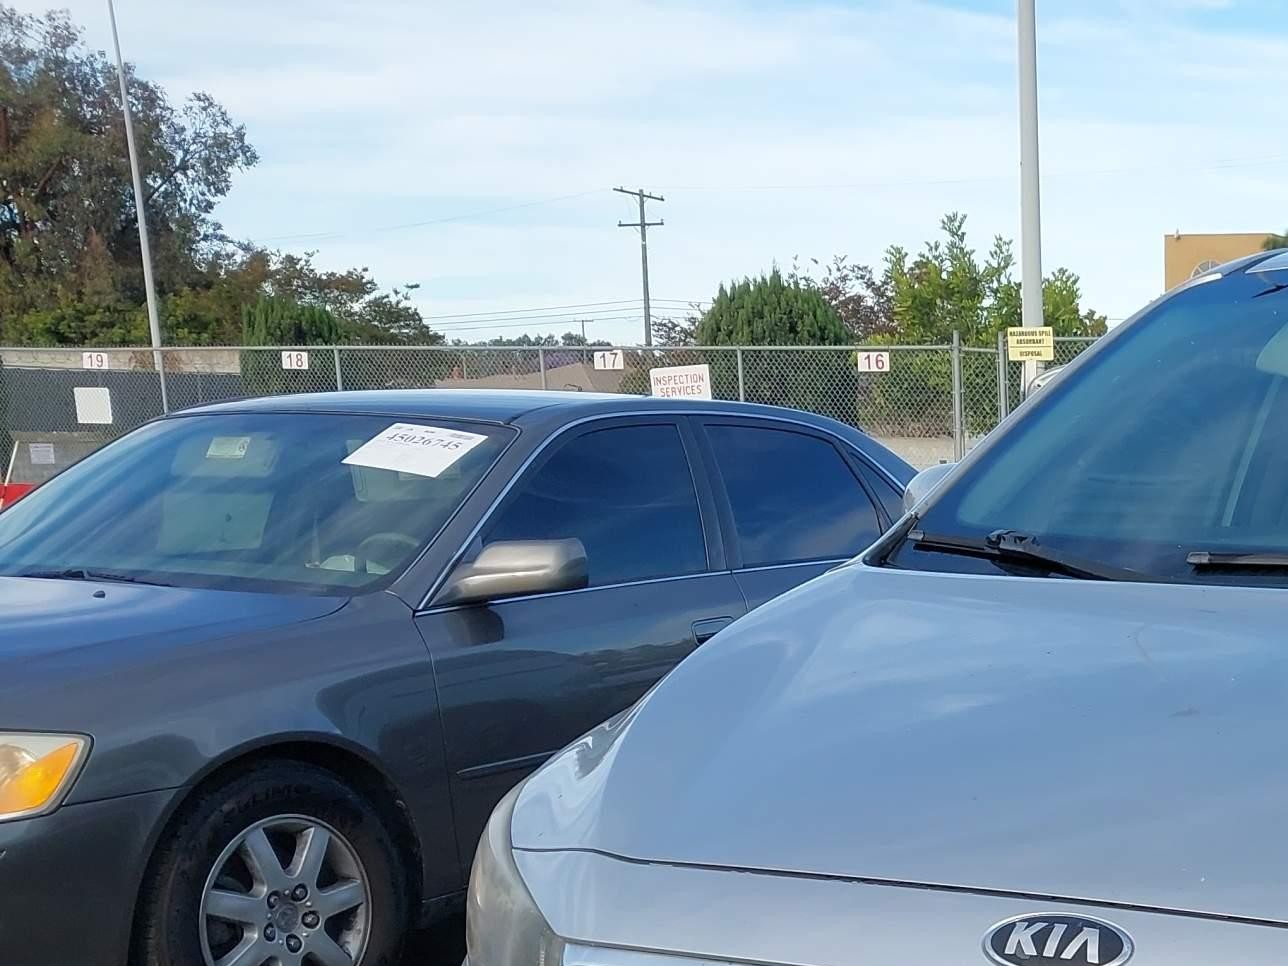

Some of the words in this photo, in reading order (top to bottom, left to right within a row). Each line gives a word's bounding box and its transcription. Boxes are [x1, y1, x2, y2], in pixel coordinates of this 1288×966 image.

[87, 353, 104, 368] 19
[286, 352, 304, 368] 18
[599, 352, 618, 369] 17
[864, 353, 885, 370] 16
[653, 373, 705, 387] INSPECTION
[659, 385, 702, 397] SERVICES
[386, 432, 462, 450] 45026745
[1003, 921, 1101, 965] KIA
